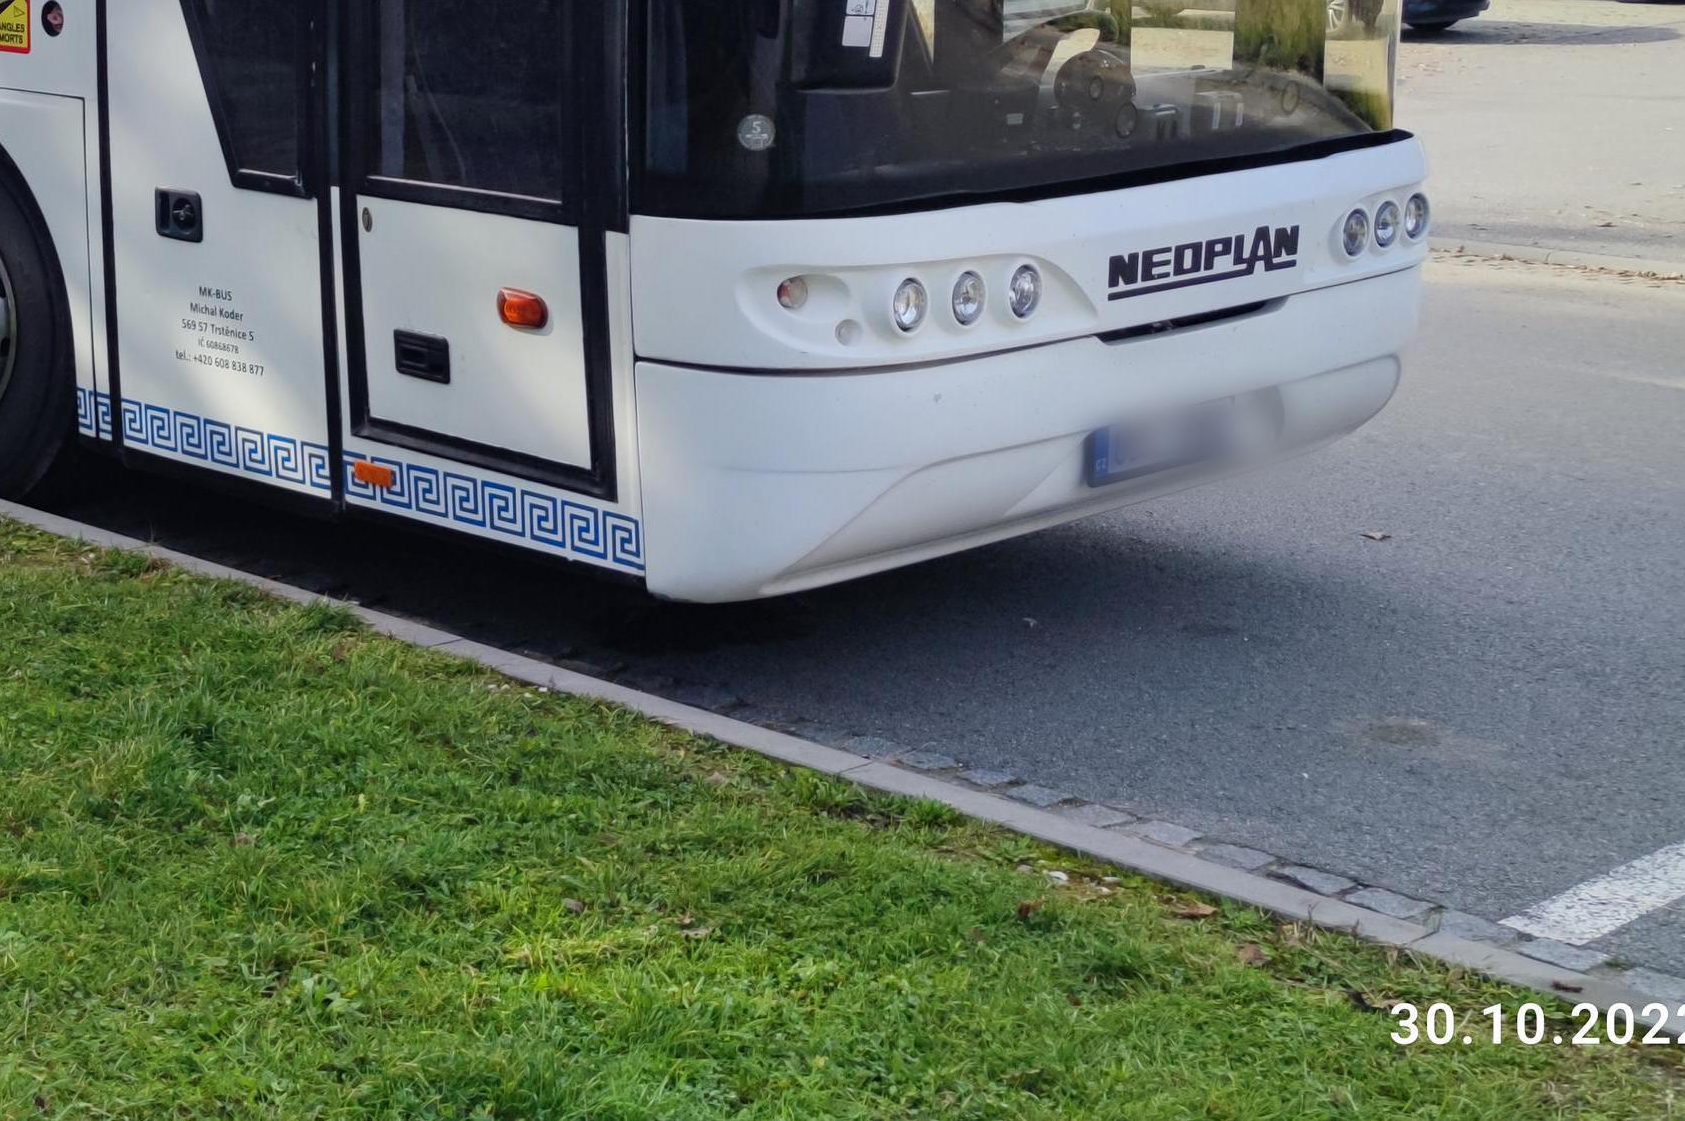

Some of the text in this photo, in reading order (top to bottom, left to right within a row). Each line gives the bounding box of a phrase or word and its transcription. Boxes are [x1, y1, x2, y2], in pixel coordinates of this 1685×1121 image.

[1107, 225, 1300, 300] NEOPLAN
[199, 286, 233, 301] MK-BUS
[189, 302, 244, 322] Michal Koder
[181, 318, 196, 330] 569
[198, 321, 208, 333] 57
[193, 354, 213, 366] +420
[214, 357, 230, 369] 608
[231, 360, 247, 373] 838
[249, 364, 264, 376] 877
